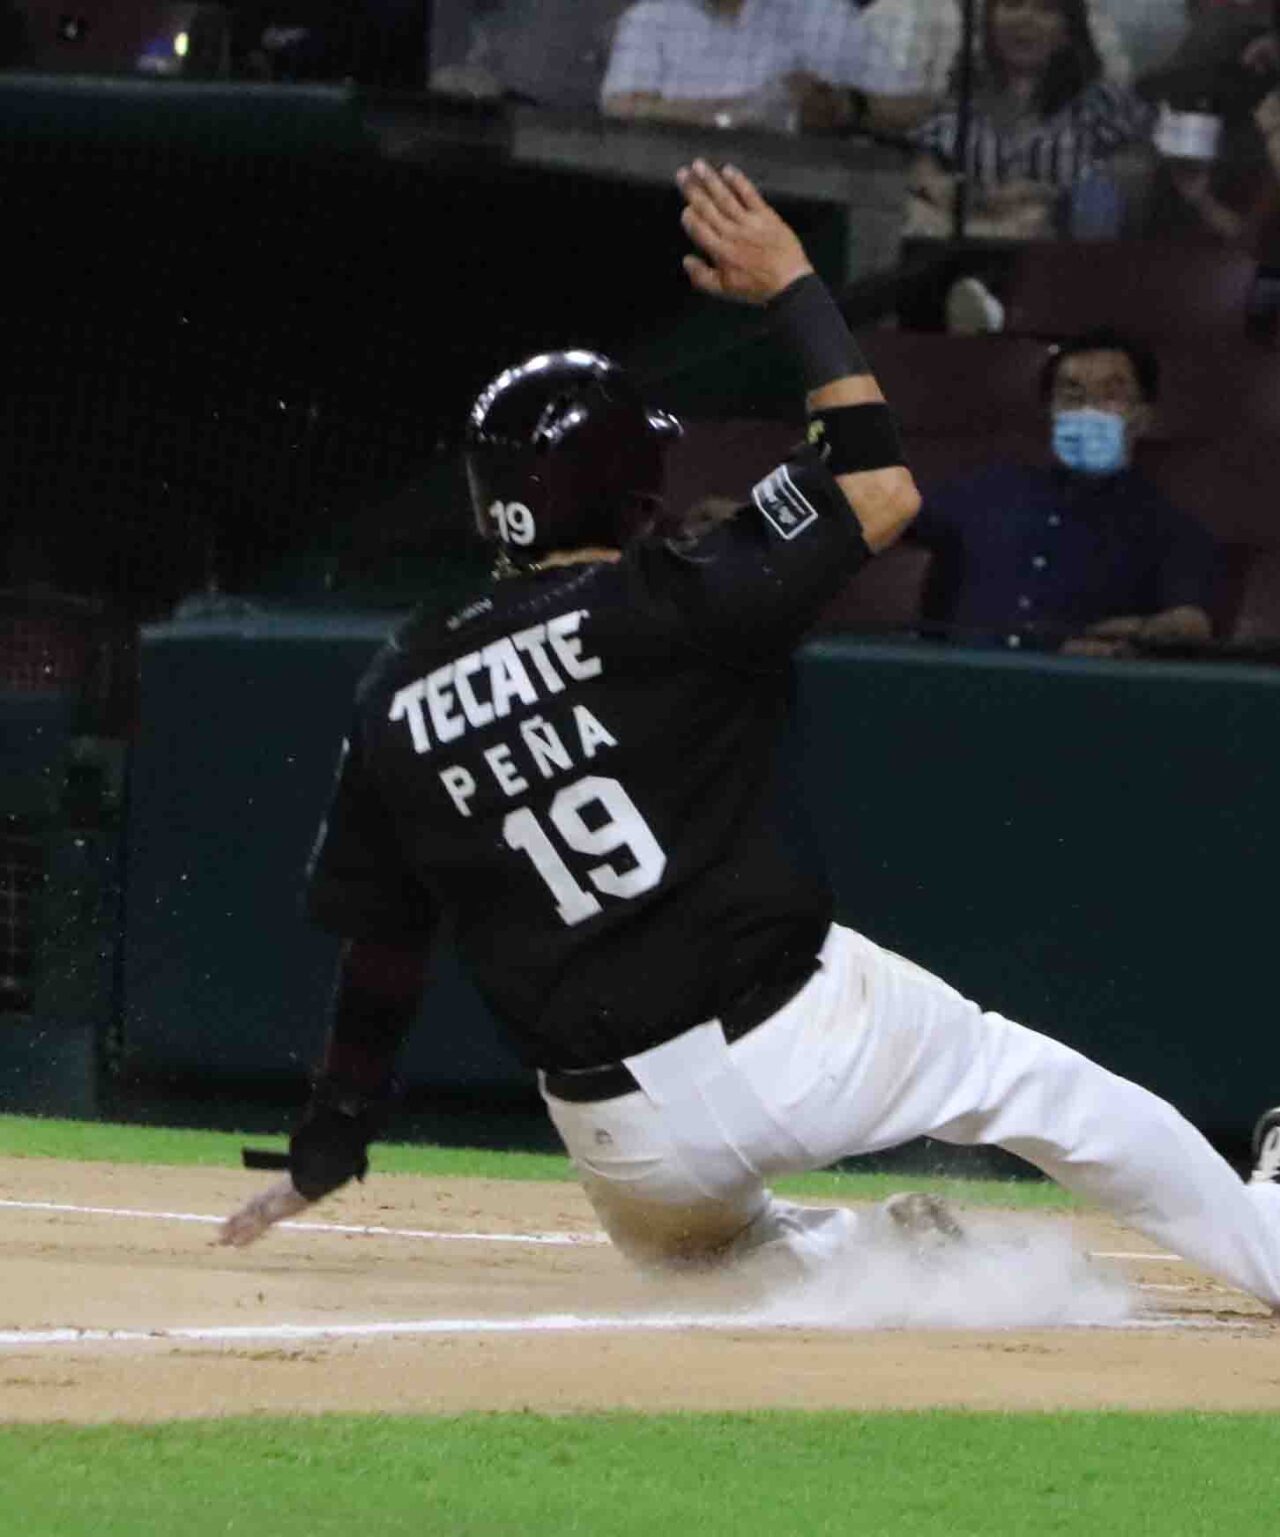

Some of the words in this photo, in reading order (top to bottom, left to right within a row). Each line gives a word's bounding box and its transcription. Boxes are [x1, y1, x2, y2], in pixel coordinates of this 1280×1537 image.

[489, 501, 536, 546] 19
[388, 609, 603, 754] TECATE
[438, 705, 619, 817] PEÑA
[502, 775, 667, 927] 19
